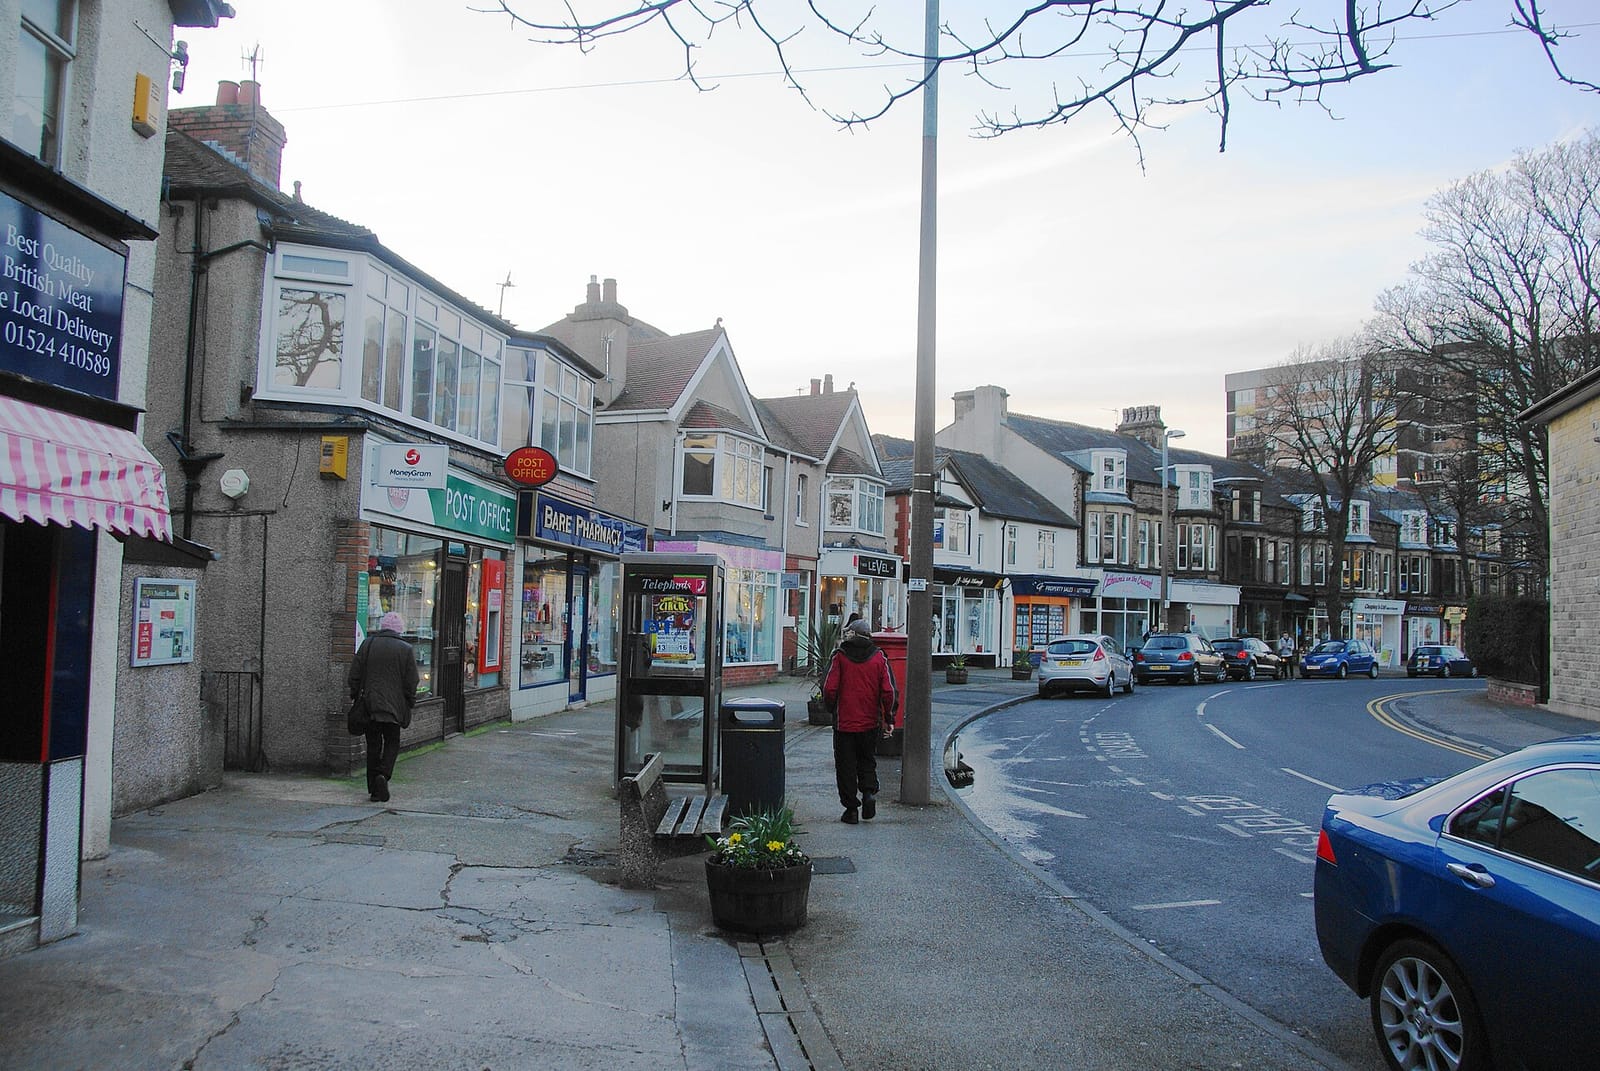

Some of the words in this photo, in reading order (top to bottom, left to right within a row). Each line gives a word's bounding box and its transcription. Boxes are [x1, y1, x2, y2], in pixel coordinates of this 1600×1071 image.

[6, 223, 39, 259] Best
[43, 243, 95, 287] Quality
[2, 254, 54, 297] British
[58, 280, 93, 313] Meat
[12, 291, 52, 327] Local
[56, 308, 113, 353] Delivery
[5, 321, 56, 358] 01524
[59, 342, 110, 377] 410589
[389, 468, 432, 478] MoneyGram
[512, 468, 547, 479] OFFICE
[517, 458, 544, 468] POST
[445, 487, 475, 523] POST
[479, 499, 511, 533] OFFICE
[543, 505, 573, 534] BARE
[575, 514, 622, 546] PHARMACY
[868, 559, 890, 575] LEVEL
[659, 602, 690, 612] CIRCUS
